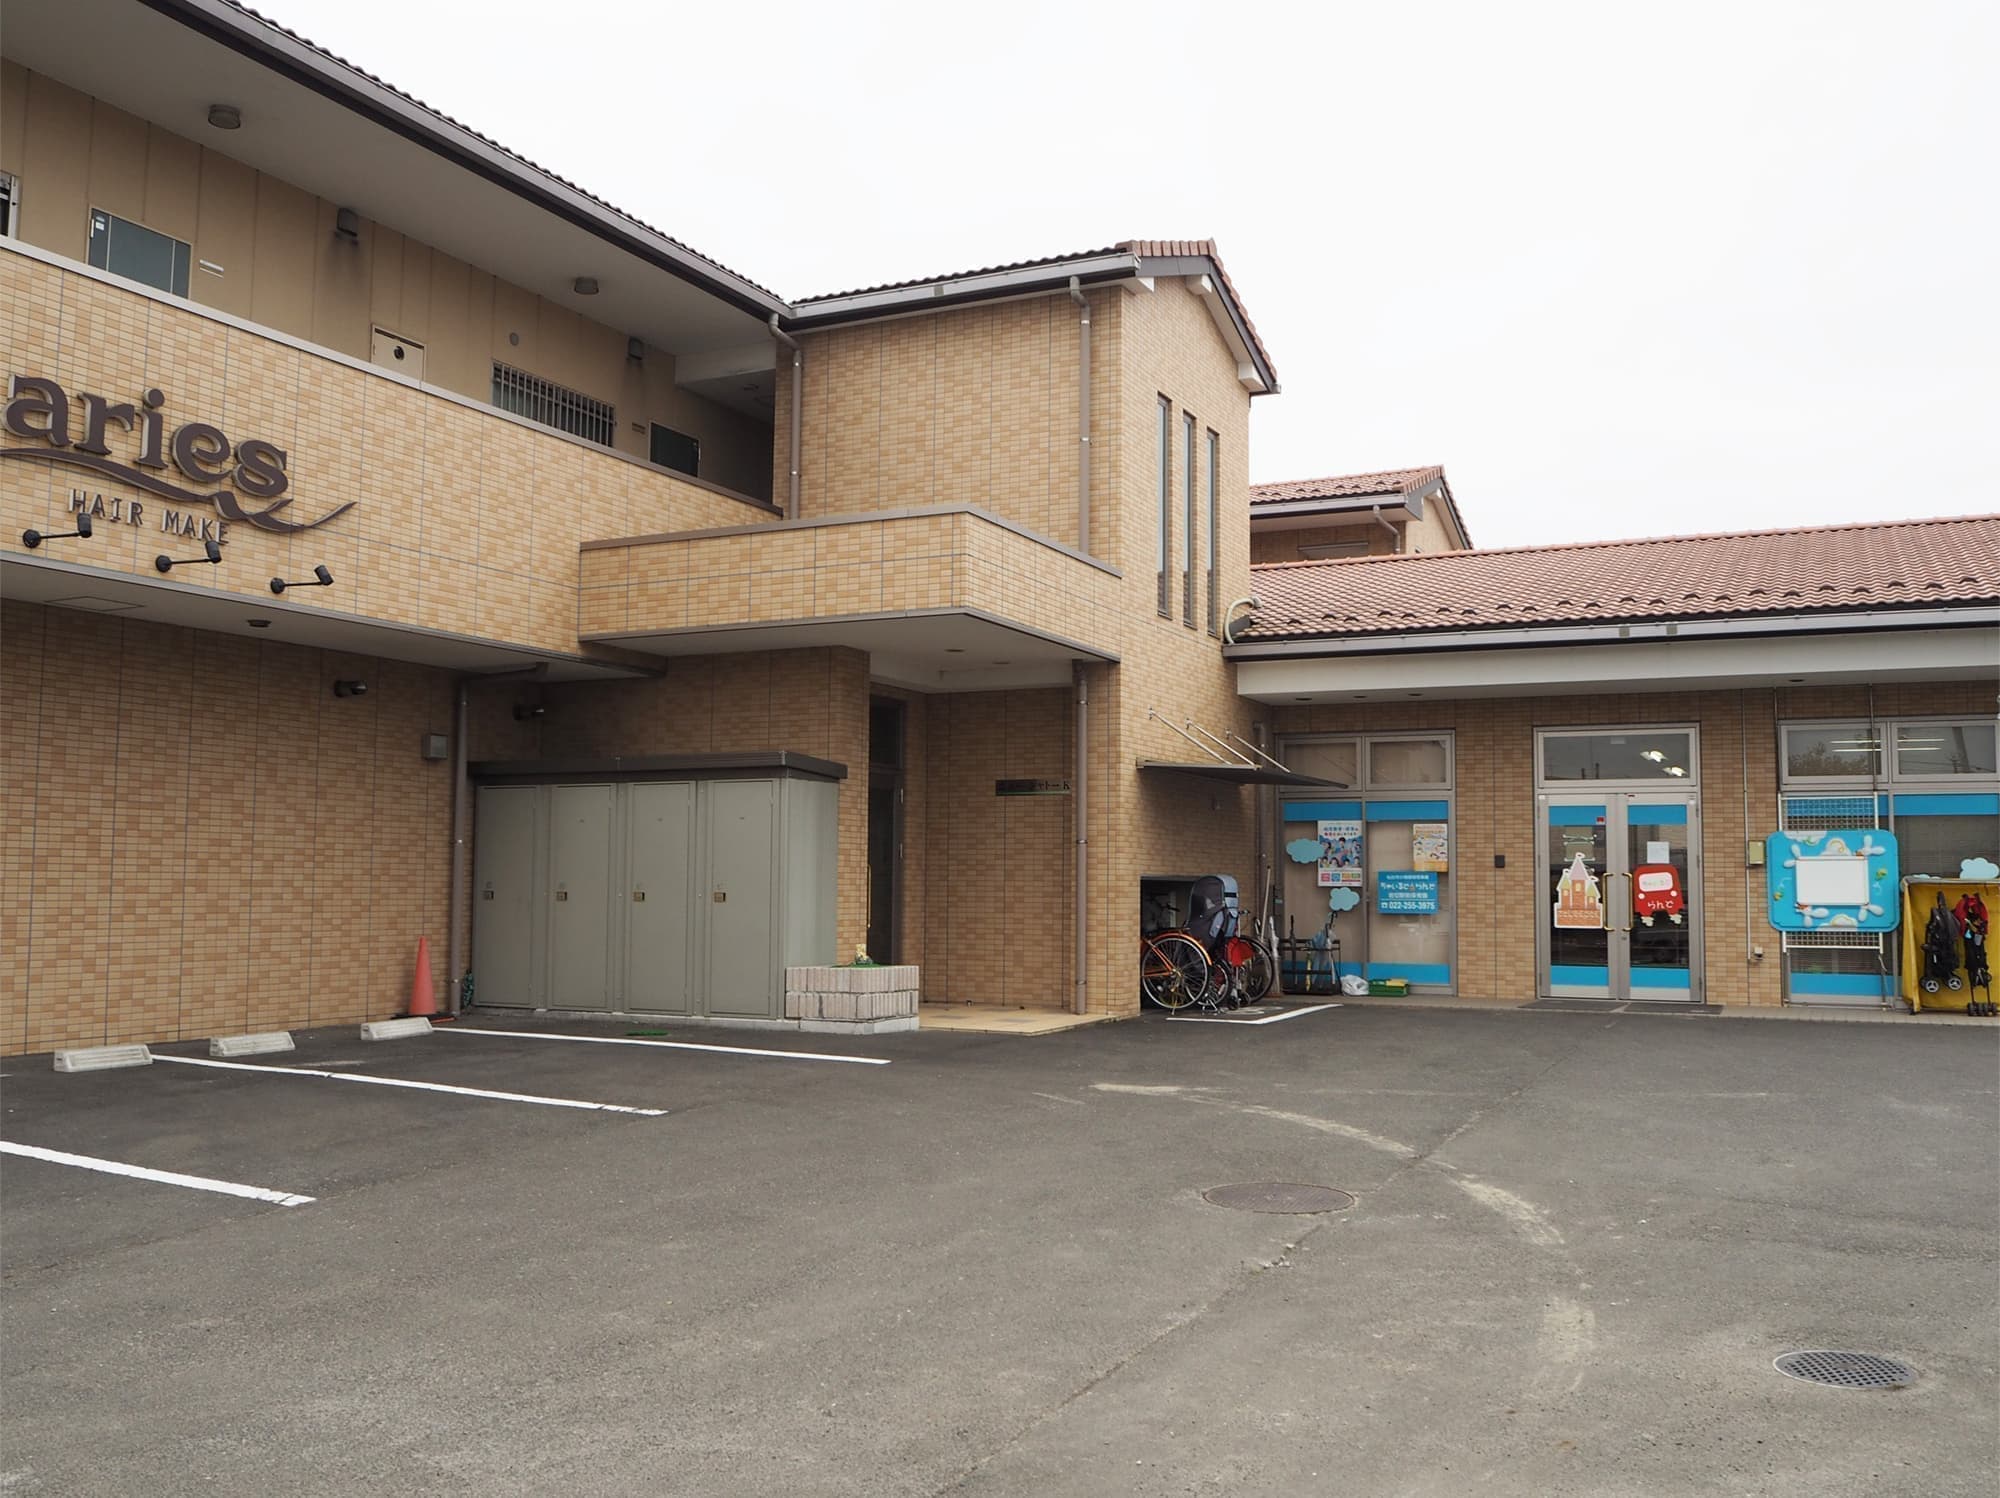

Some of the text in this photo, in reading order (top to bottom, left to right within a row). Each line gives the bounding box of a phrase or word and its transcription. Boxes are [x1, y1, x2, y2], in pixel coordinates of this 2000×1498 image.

[1, 374, 289, 497] aries
[68, 488, 230, 545] HAIR MAKE
